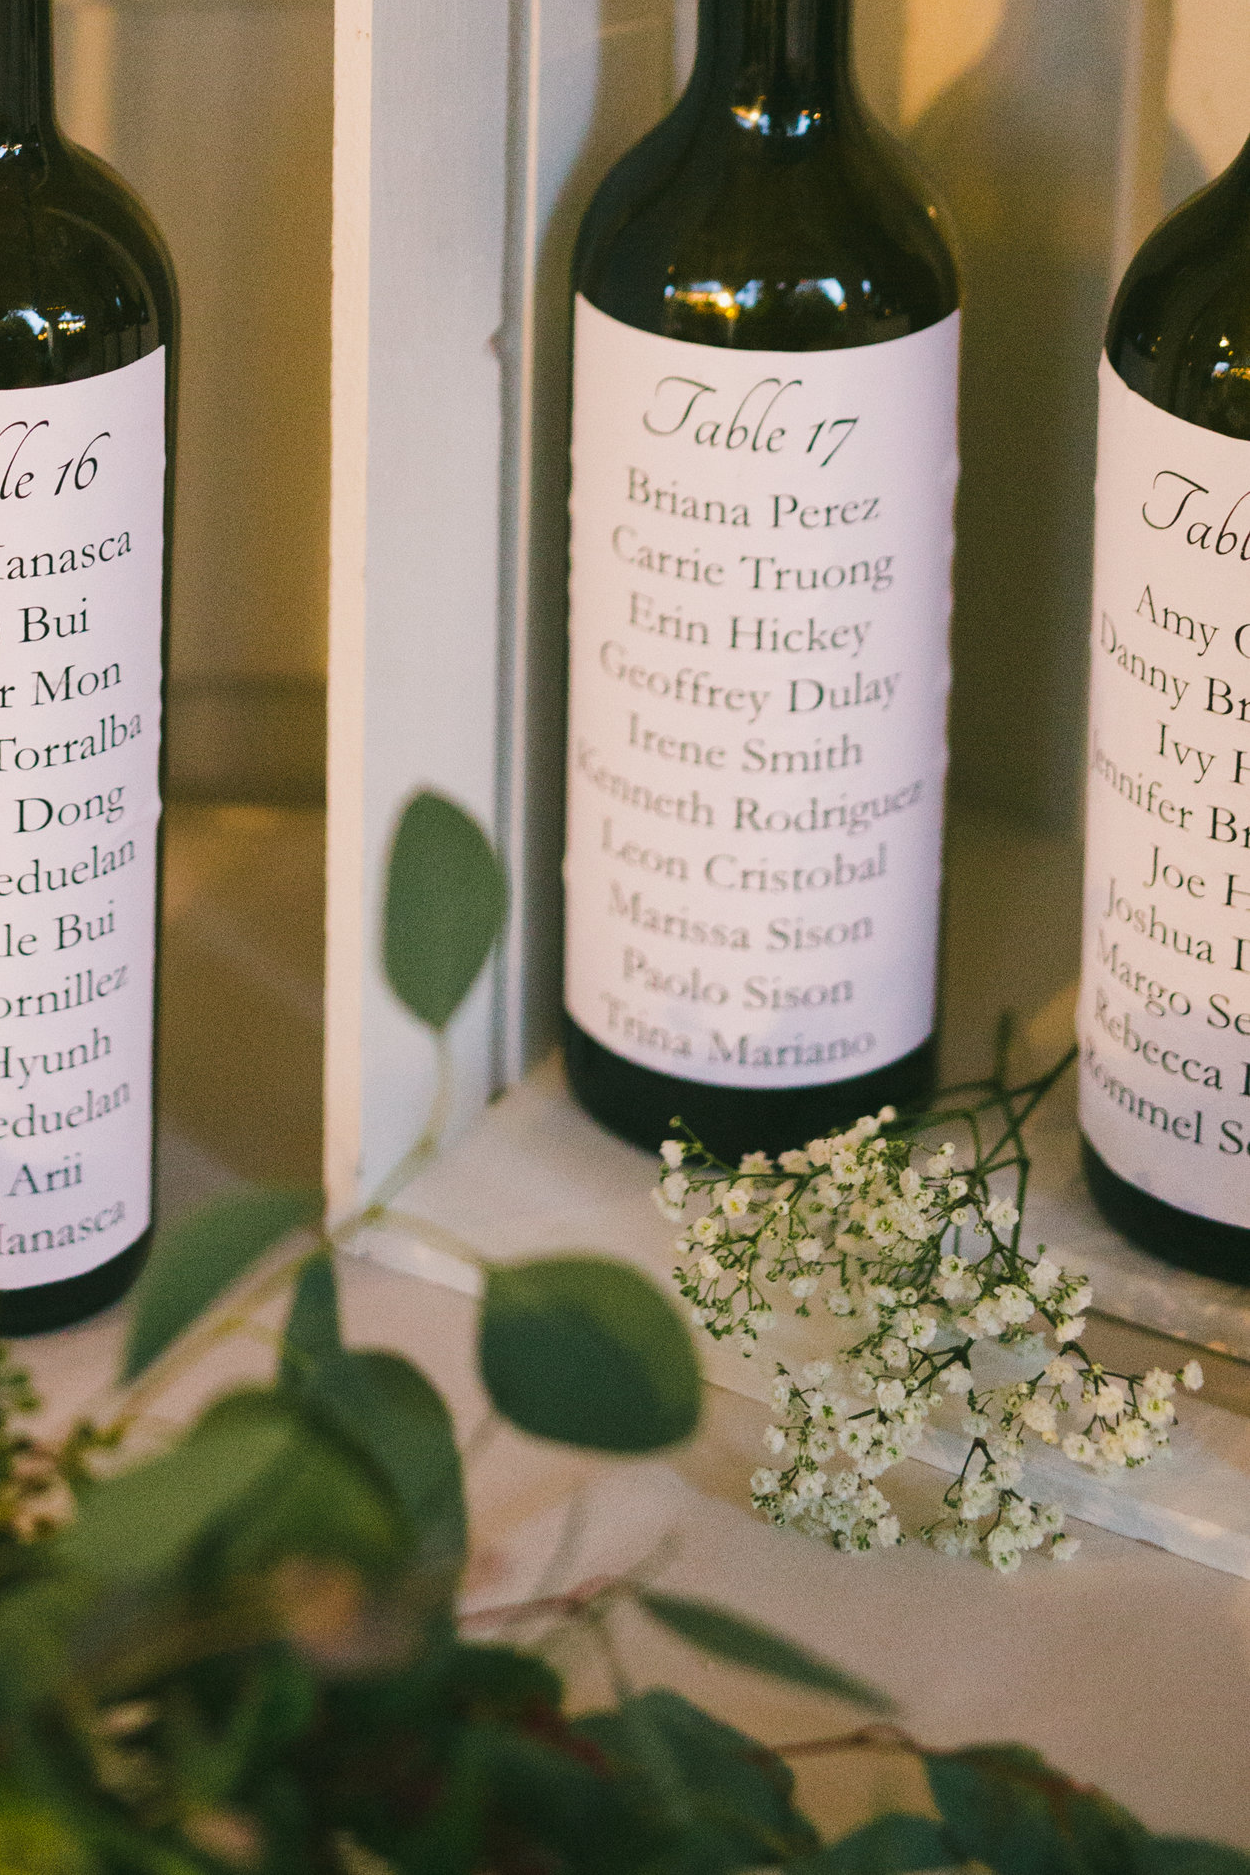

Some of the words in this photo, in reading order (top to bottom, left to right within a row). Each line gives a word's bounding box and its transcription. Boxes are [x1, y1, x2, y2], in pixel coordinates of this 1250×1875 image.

[643, 375, 803, 455] Table
[807, 416, 860, 468] 17
[54, 431, 111, 496] 16
[625, 465, 752, 529] Briana
[771, 492, 882, 529] Perez
[611, 523, 725, 590] Carrie
[739, 552, 896, 592] Truong
[17, 597, 91, 644] Bui
[628, 591, 711, 646] Erin
[729, 615, 872, 657] Hickey
[1137, 584, 1219, 657] Amy
[31, 662, 122, 707] Mon
[599, 639, 771, 724] Geoffrey
[789, 667, 902, 715] Dulay
[1100, 611, 1190, 710] Danny
[628, 709, 728, 770] Irene
[742, 733, 863, 773] Smith
[1158, 720, 1217, 784] Ivy
[13, 785, 126, 835] Dong
[602, 816, 690, 882] Leon
[704, 841, 888, 893] Cristobal
[1142, 841, 1206, 899] Joe
[52, 899, 116, 951] Bui
[1103, 876, 1215, 965] Joshua
[1099, 927, 1191, 1017] Margo
[1095, 985, 1223, 1090] Rebecca
[7, 1151, 83, 1196] Arii
